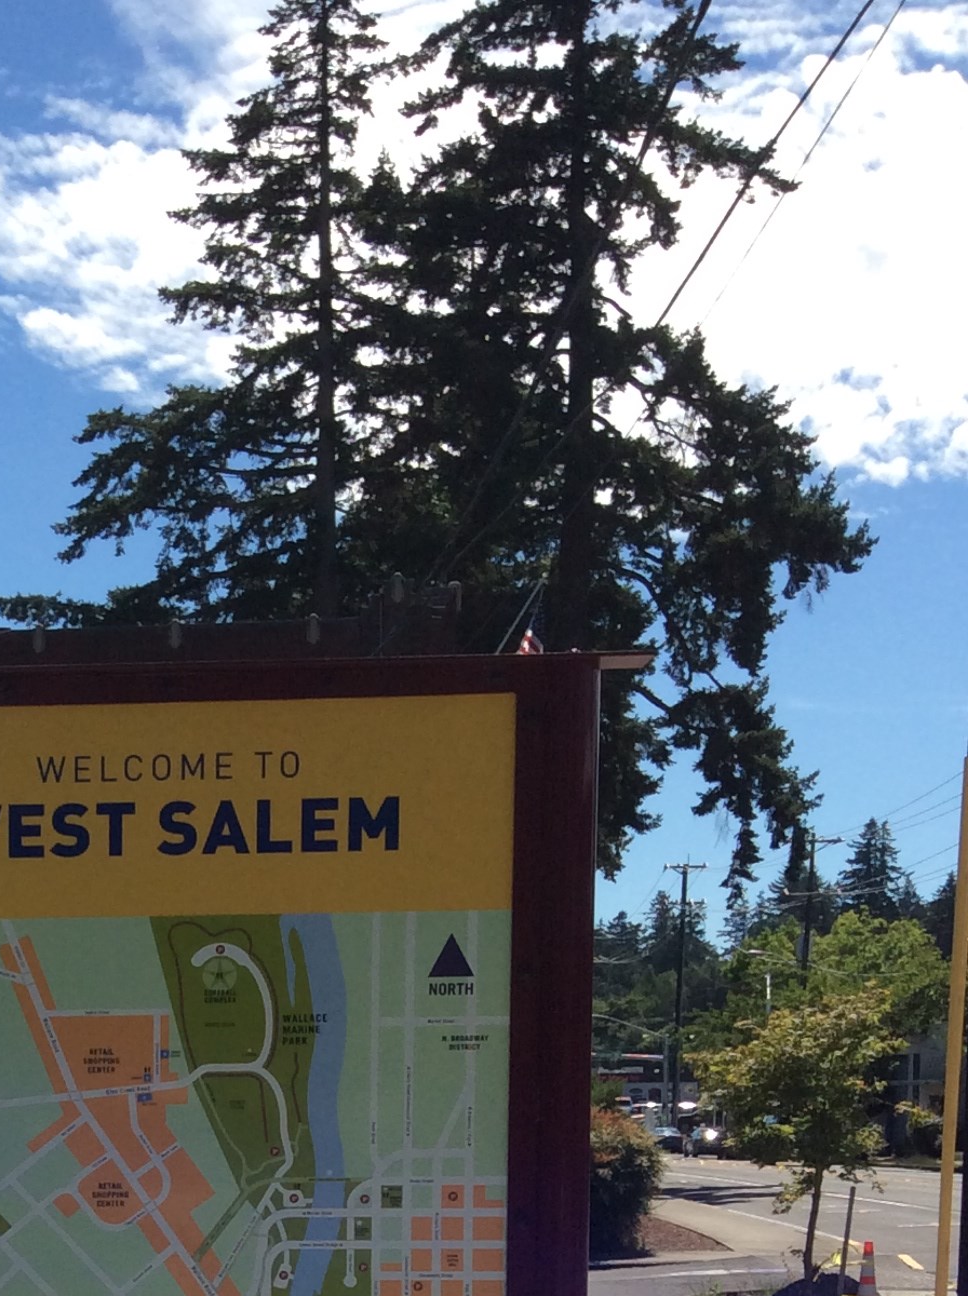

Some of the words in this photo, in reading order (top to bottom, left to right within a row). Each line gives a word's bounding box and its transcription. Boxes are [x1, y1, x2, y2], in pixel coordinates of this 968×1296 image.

[36, 752, 234, 784] WELCOME
[253, 750, 301, 780] TO
[158, 796, 400, 856] SALEM
[428, 982, 474, 996] NORTH
[282, 1014, 328, 1024] WALLACE
[282, 1025, 321, 1034] MARINE
[282, 1036, 307, 1045] PARK
[450, 1034, 489, 1042] BROADWAY
[449, 1043, 481, 1051] DISTRICT
[89, 1048, 114, 1056] RETAIL
[83, 1057, 120, 1065] SHOPPING
[87, 1066, 116, 1074] CENTER
[98, 1182, 123, 1190] RETAIL
[92, 1191, 129, 1199] SHOPPING
[96, 1199, 125, 1207] CENTER
